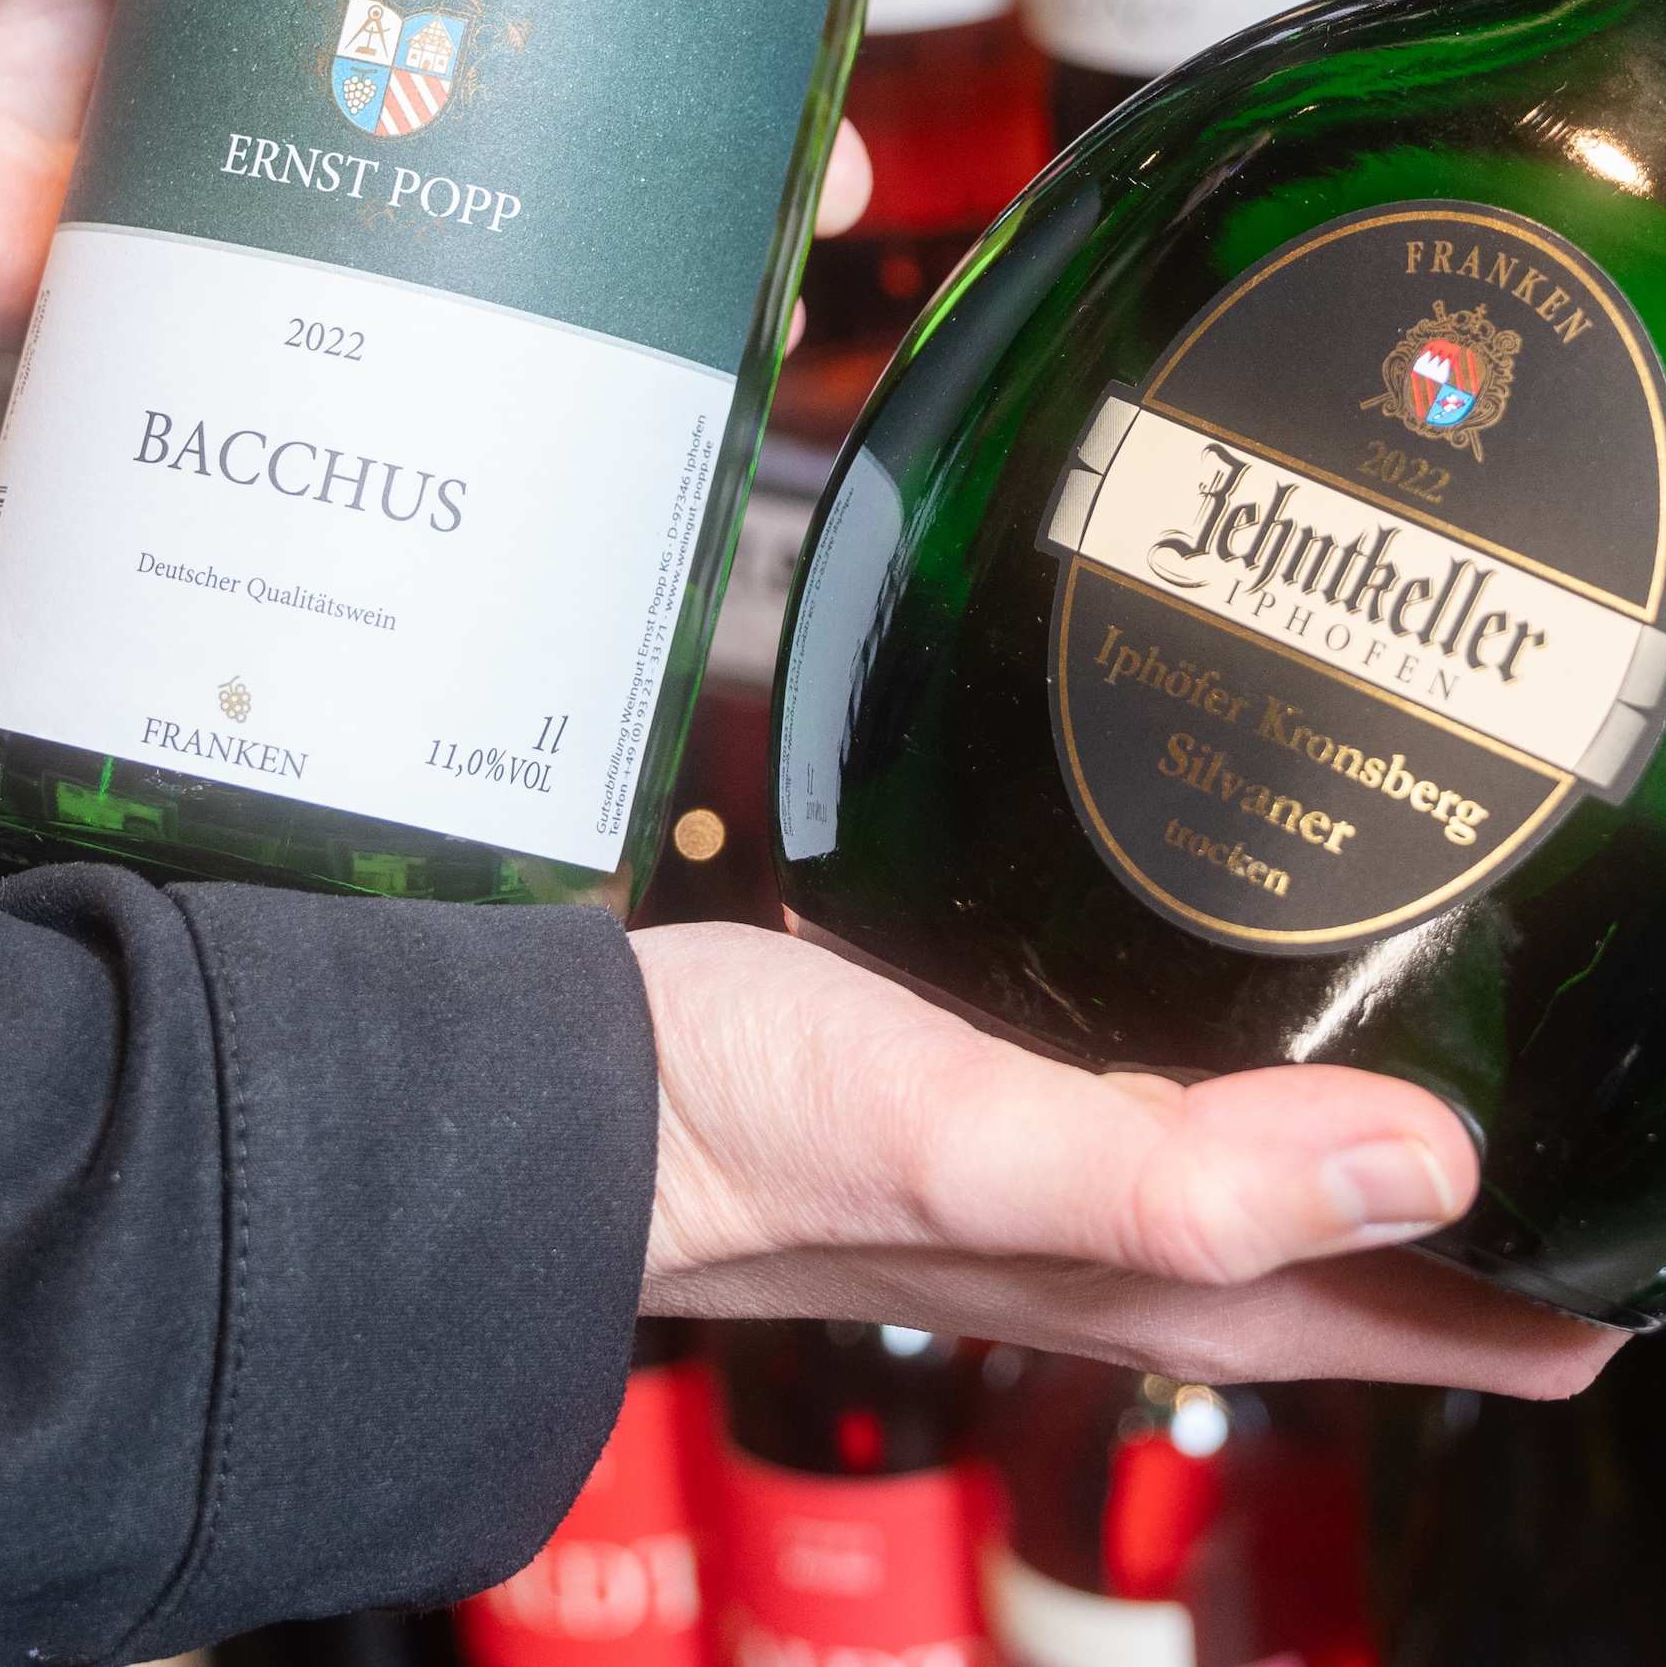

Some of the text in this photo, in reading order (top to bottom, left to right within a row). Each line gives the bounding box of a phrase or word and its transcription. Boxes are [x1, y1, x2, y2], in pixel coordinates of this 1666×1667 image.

[219, 131, 523, 236] ERNST POPP
[284, 317, 366, 362] 2022
[1406, 239, 1593, 346] FRANKEN
[132, 409, 468, 533] BACCHUS
[1354, 438, 1452, 506] 2022
[136, 551, 398, 632] Deutscher Qualitätswein
[596, 413, 708, 835] Gutsabfüllung Weingut Ernst Popp KG D-97346 Iphofen
[607, 439, 715, 837] Telefon +49 (0) 93 23 33 71 www.weingut-popp.de
[1226, 576, 1462, 703] IPHOFEN
[140, 716, 310, 780] FRANKEN
[531, 714, 570, 755] 1l
[1093, 623, 1490, 846] Iphöfer Kronsberg
[1157, 731, 1357, 857] Silvaner
[1163, 812, 1293, 898] trocken
